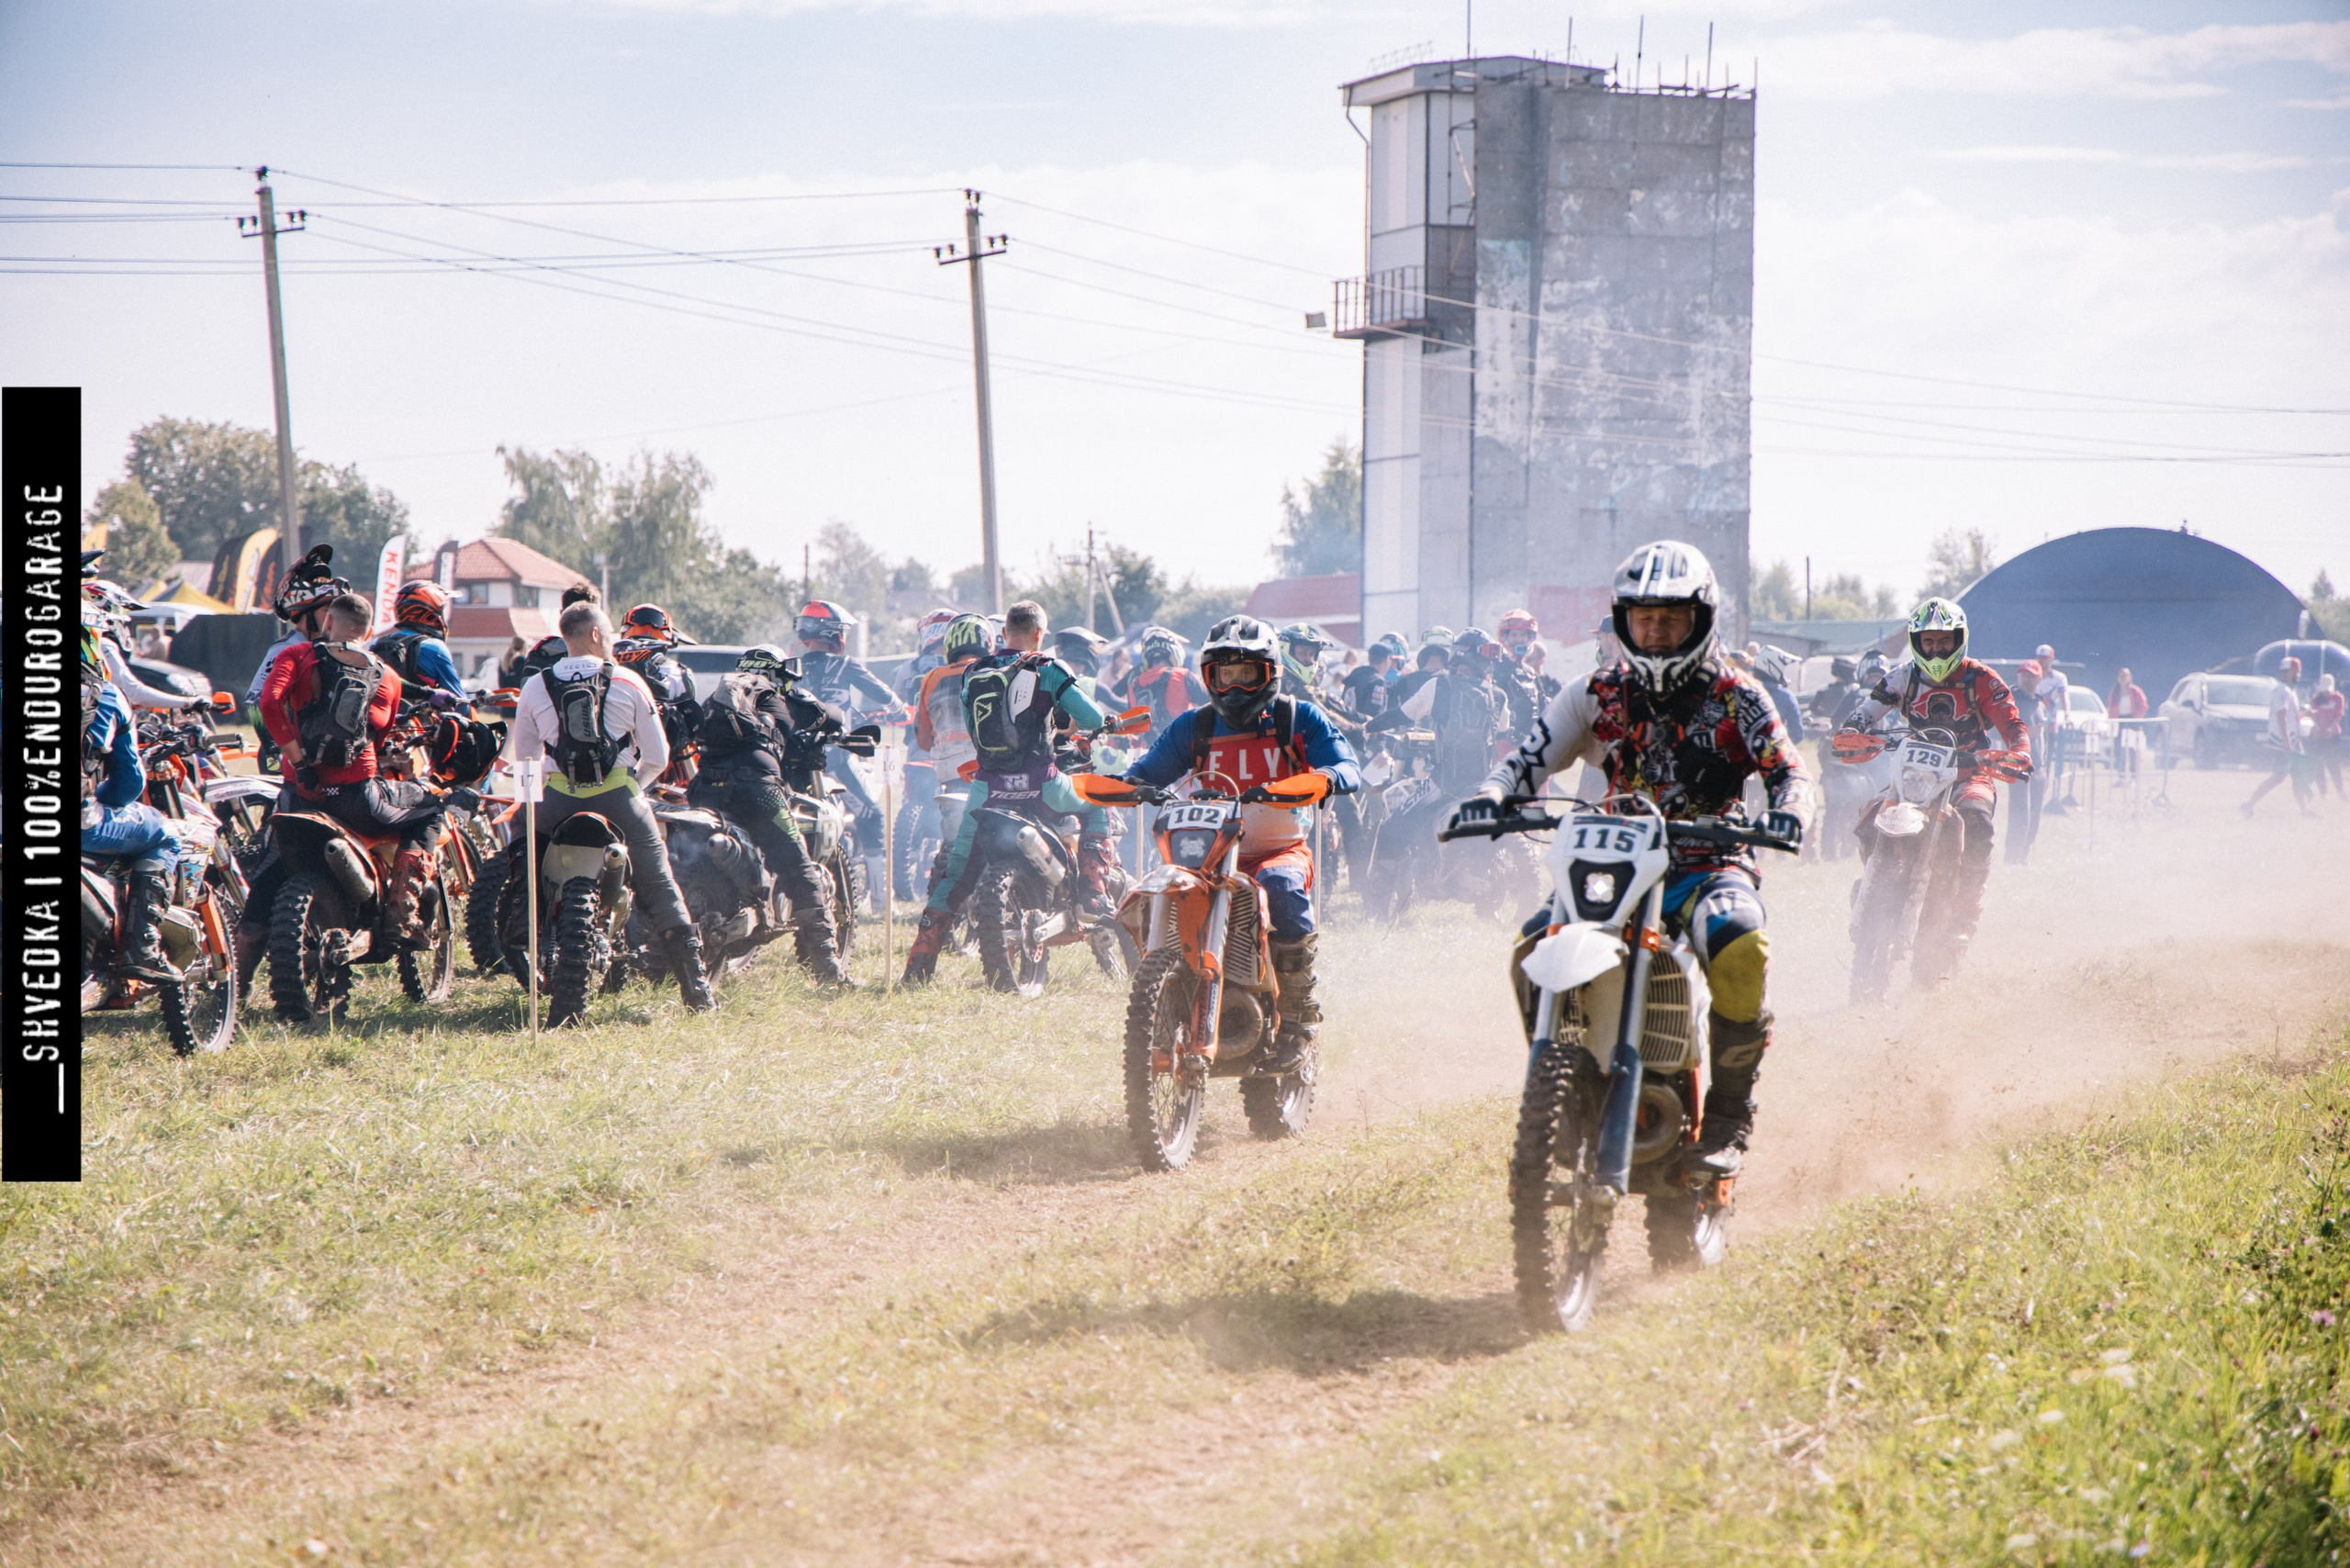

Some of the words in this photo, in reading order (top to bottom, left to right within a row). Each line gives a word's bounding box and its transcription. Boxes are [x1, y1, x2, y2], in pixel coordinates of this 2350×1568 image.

[382, 551, 398, 624] KENDA
[737, 658, 783, 669] 100%
[580, 700, 592, 738] USWE
[882, 761, 895, 772] 16
[1208, 747, 1281, 781] FLY
[1906, 749, 1942, 768] 129
[520, 774, 535, 788] 17
[990, 790, 1041, 801] TIGER
[1174, 807, 1220, 824] 102
[1573, 827, 1637, 854] 115
